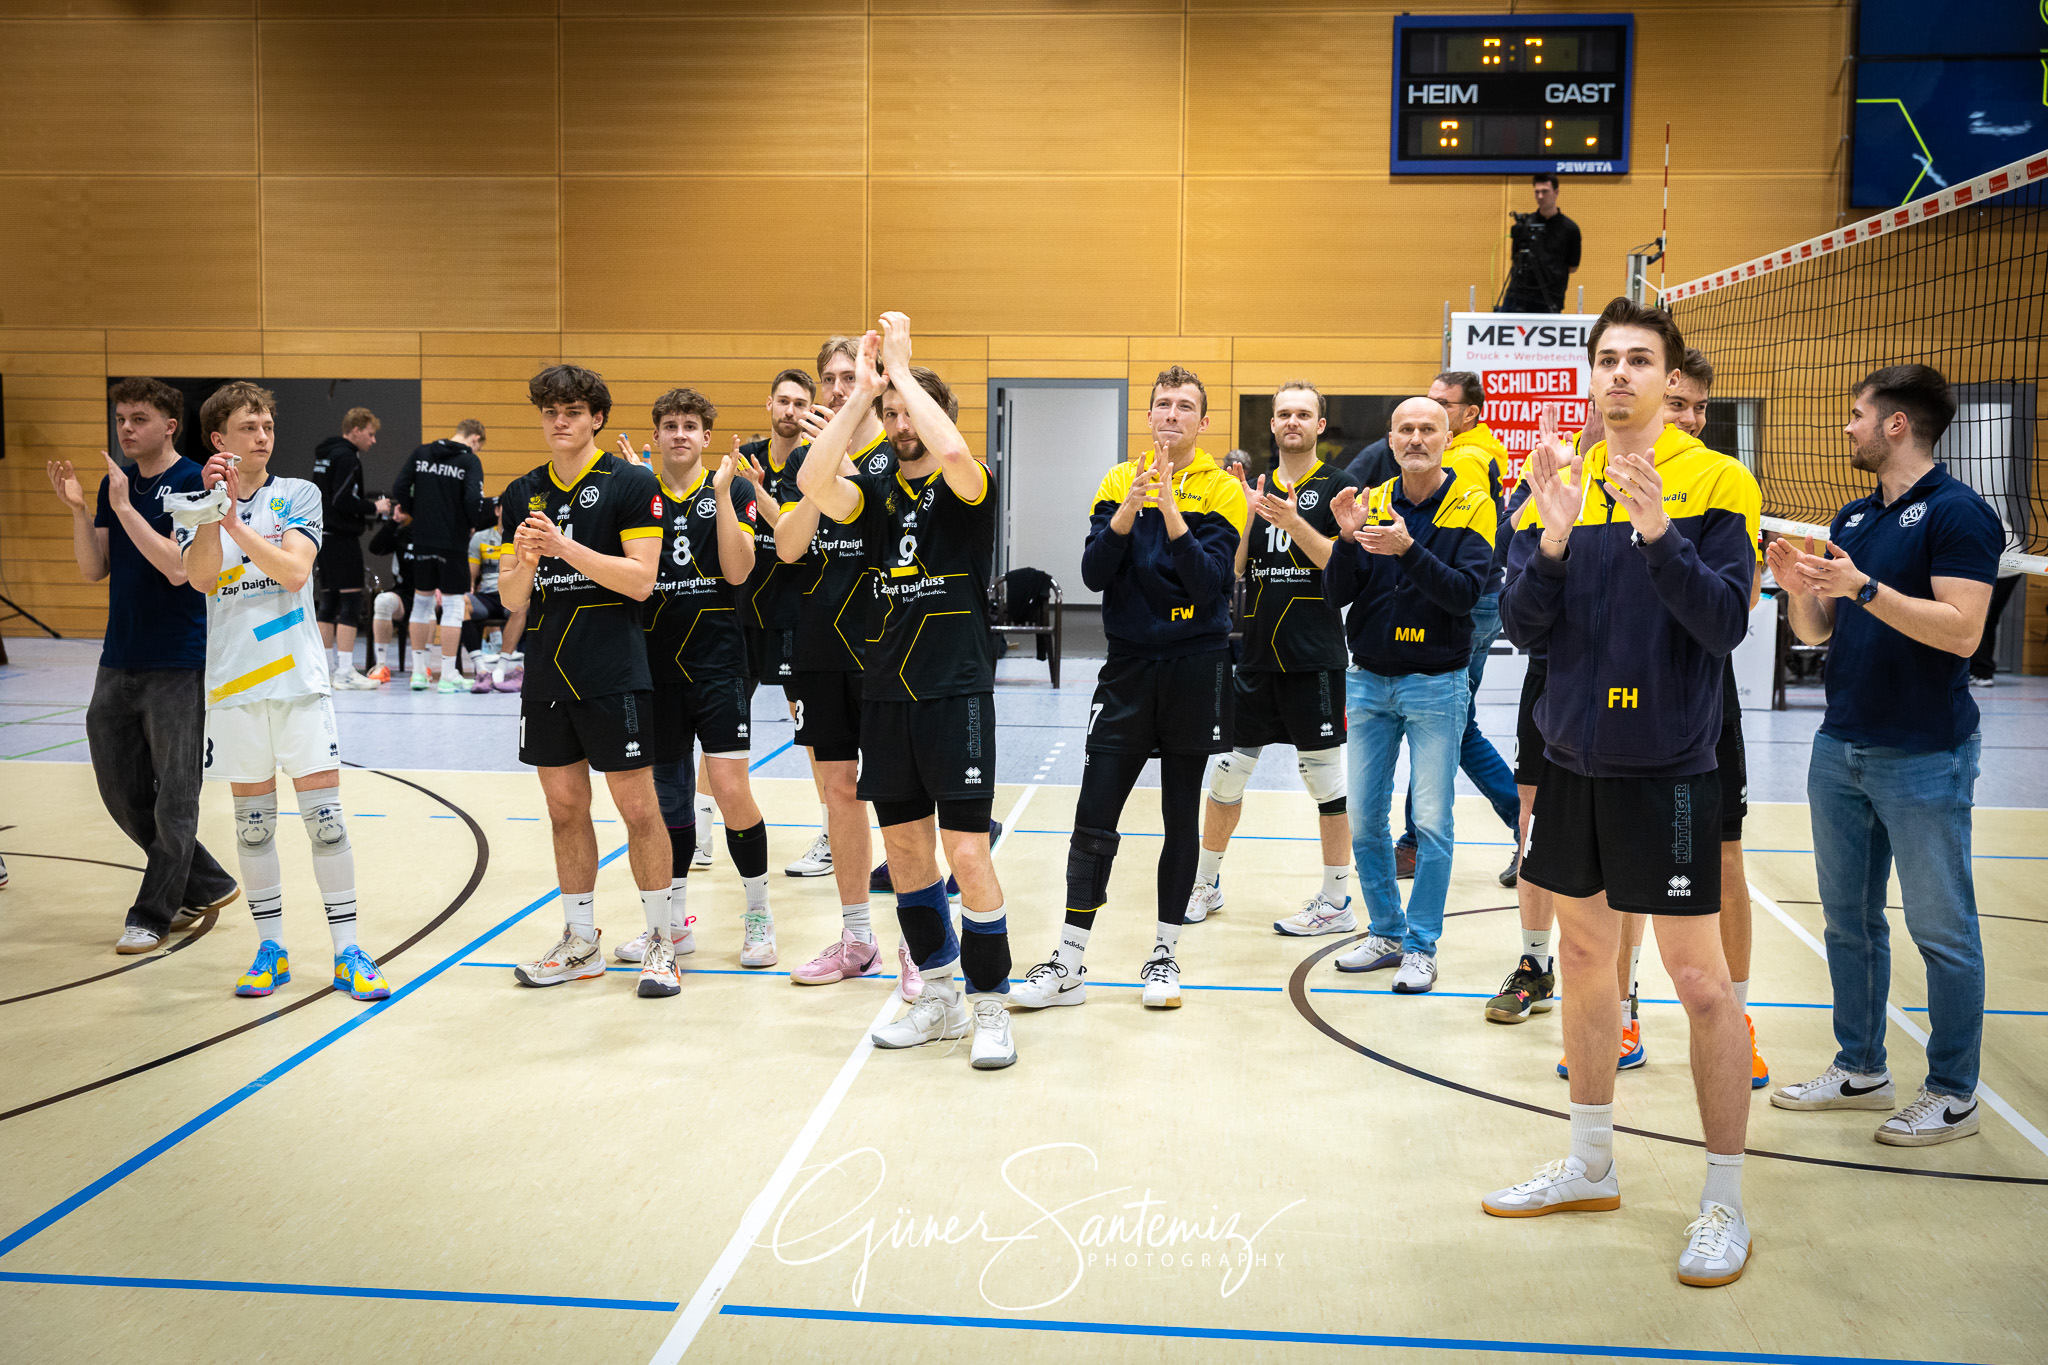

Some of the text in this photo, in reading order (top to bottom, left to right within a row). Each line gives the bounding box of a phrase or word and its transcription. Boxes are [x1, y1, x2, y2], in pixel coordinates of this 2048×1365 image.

[1408, 83, 1616, 104] HEIM GAST
[1556, 161, 1613, 172] PEWETA
[1466, 351, 1499, 360] Druck
[1514, 351, 1587, 361] Werbetechni
[1486, 371, 1571, 395] SCHILDER
[1479, 400, 1585, 423] OTOTAPTEN
[416, 460, 466, 480] GRAFING
[155, 486, 172, 499] JD
[1265, 524, 1292, 553] 10
[673, 536, 692, 566] 8
[897, 535, 918, 567] 9
[554, 572, 592, 585] Daigfus
[1254, 566, 1311, 578] Zapf Daigfuss
[221, 577, 282, 596] Zap Daigfu
[654, 580, 677, 592] Zapf
[881, 584, 900, 596] Zapf
[1170, 605, 1194, 622] FW
[1395, 627, 1425, 643] MM
[1607, 687, 1639, 709] FH
[1087, 703, 1104, 735] 7
[1667, 889, 1692, 897] errea
